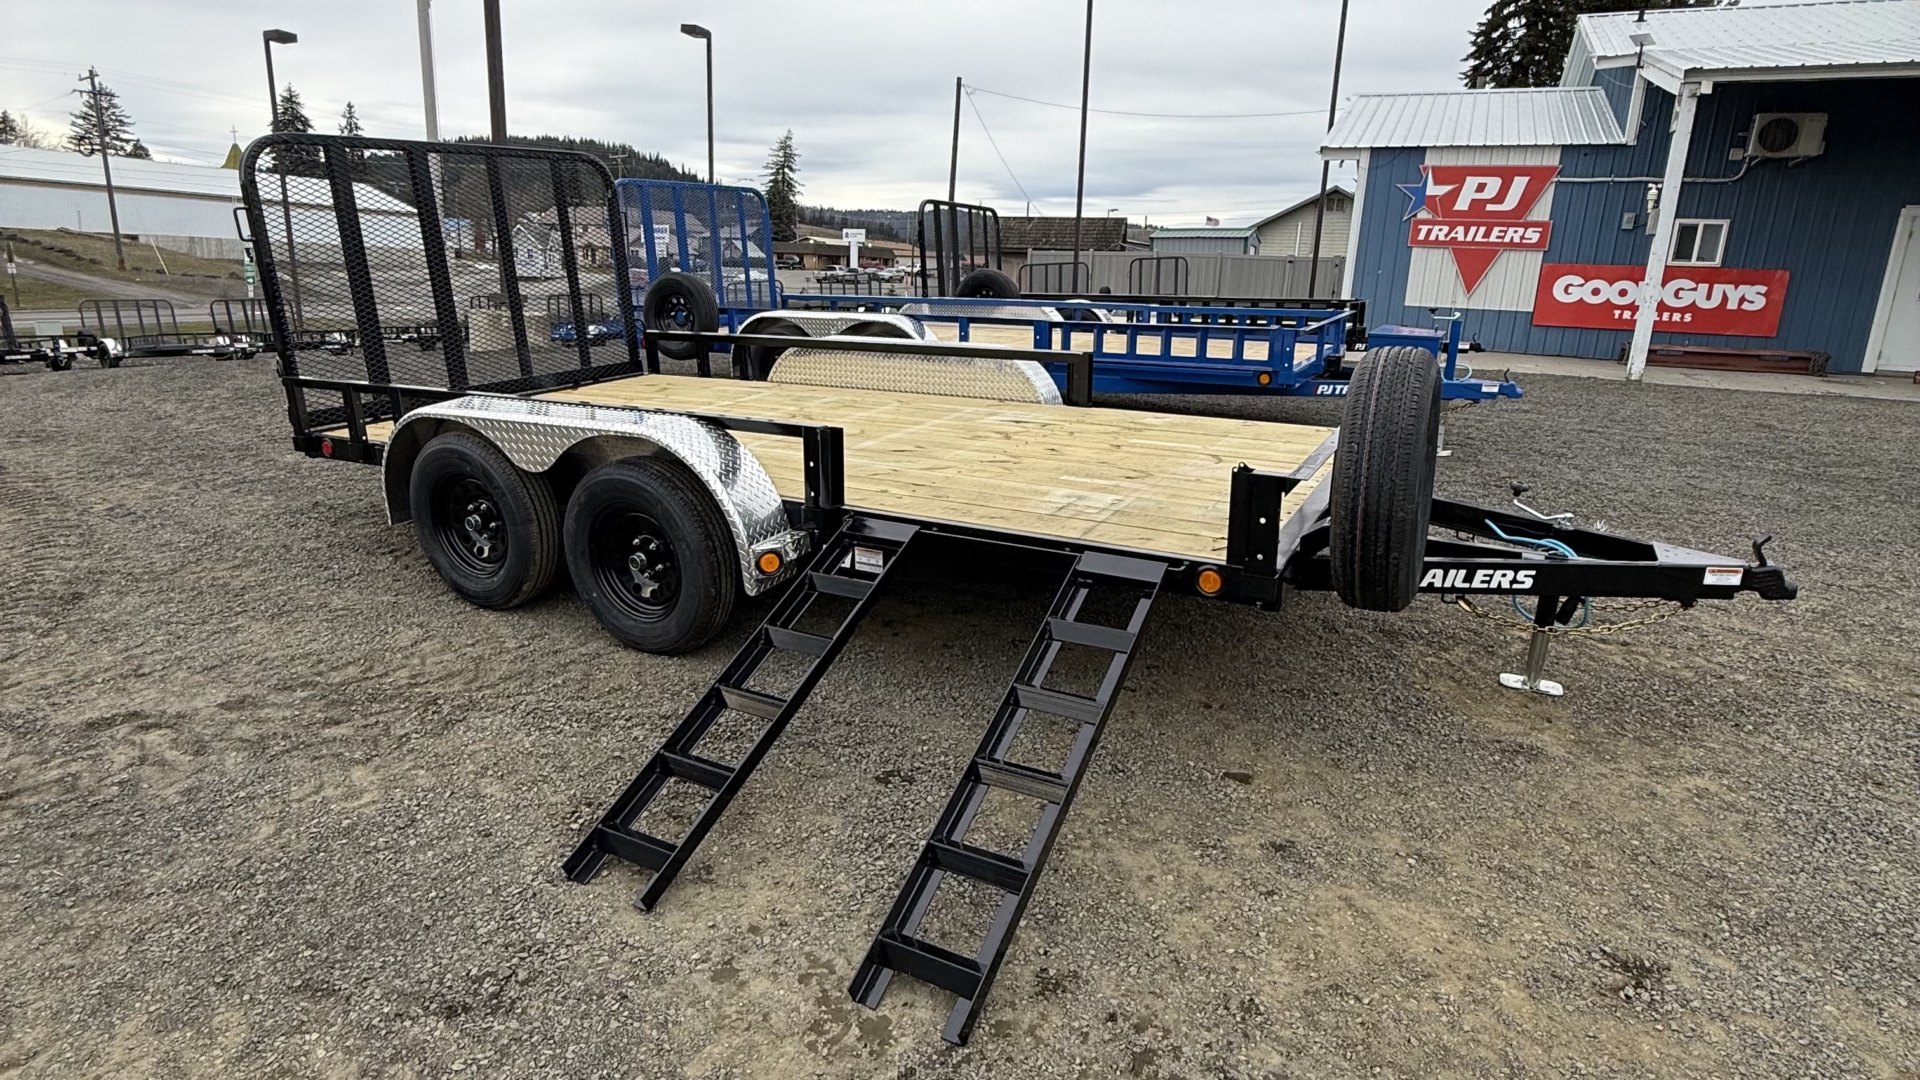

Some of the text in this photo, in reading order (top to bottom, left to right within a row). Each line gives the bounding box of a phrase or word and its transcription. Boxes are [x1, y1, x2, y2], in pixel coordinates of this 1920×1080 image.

[1452, 176, 1531, 212] PJ
[1417, 224, 1543, 244] TRAILERS
[1613, 309, 1692, 322] TRLERS
[1316, 384, 1334, 395] PJ
[1419, 568, 1537, 589] AILERS
